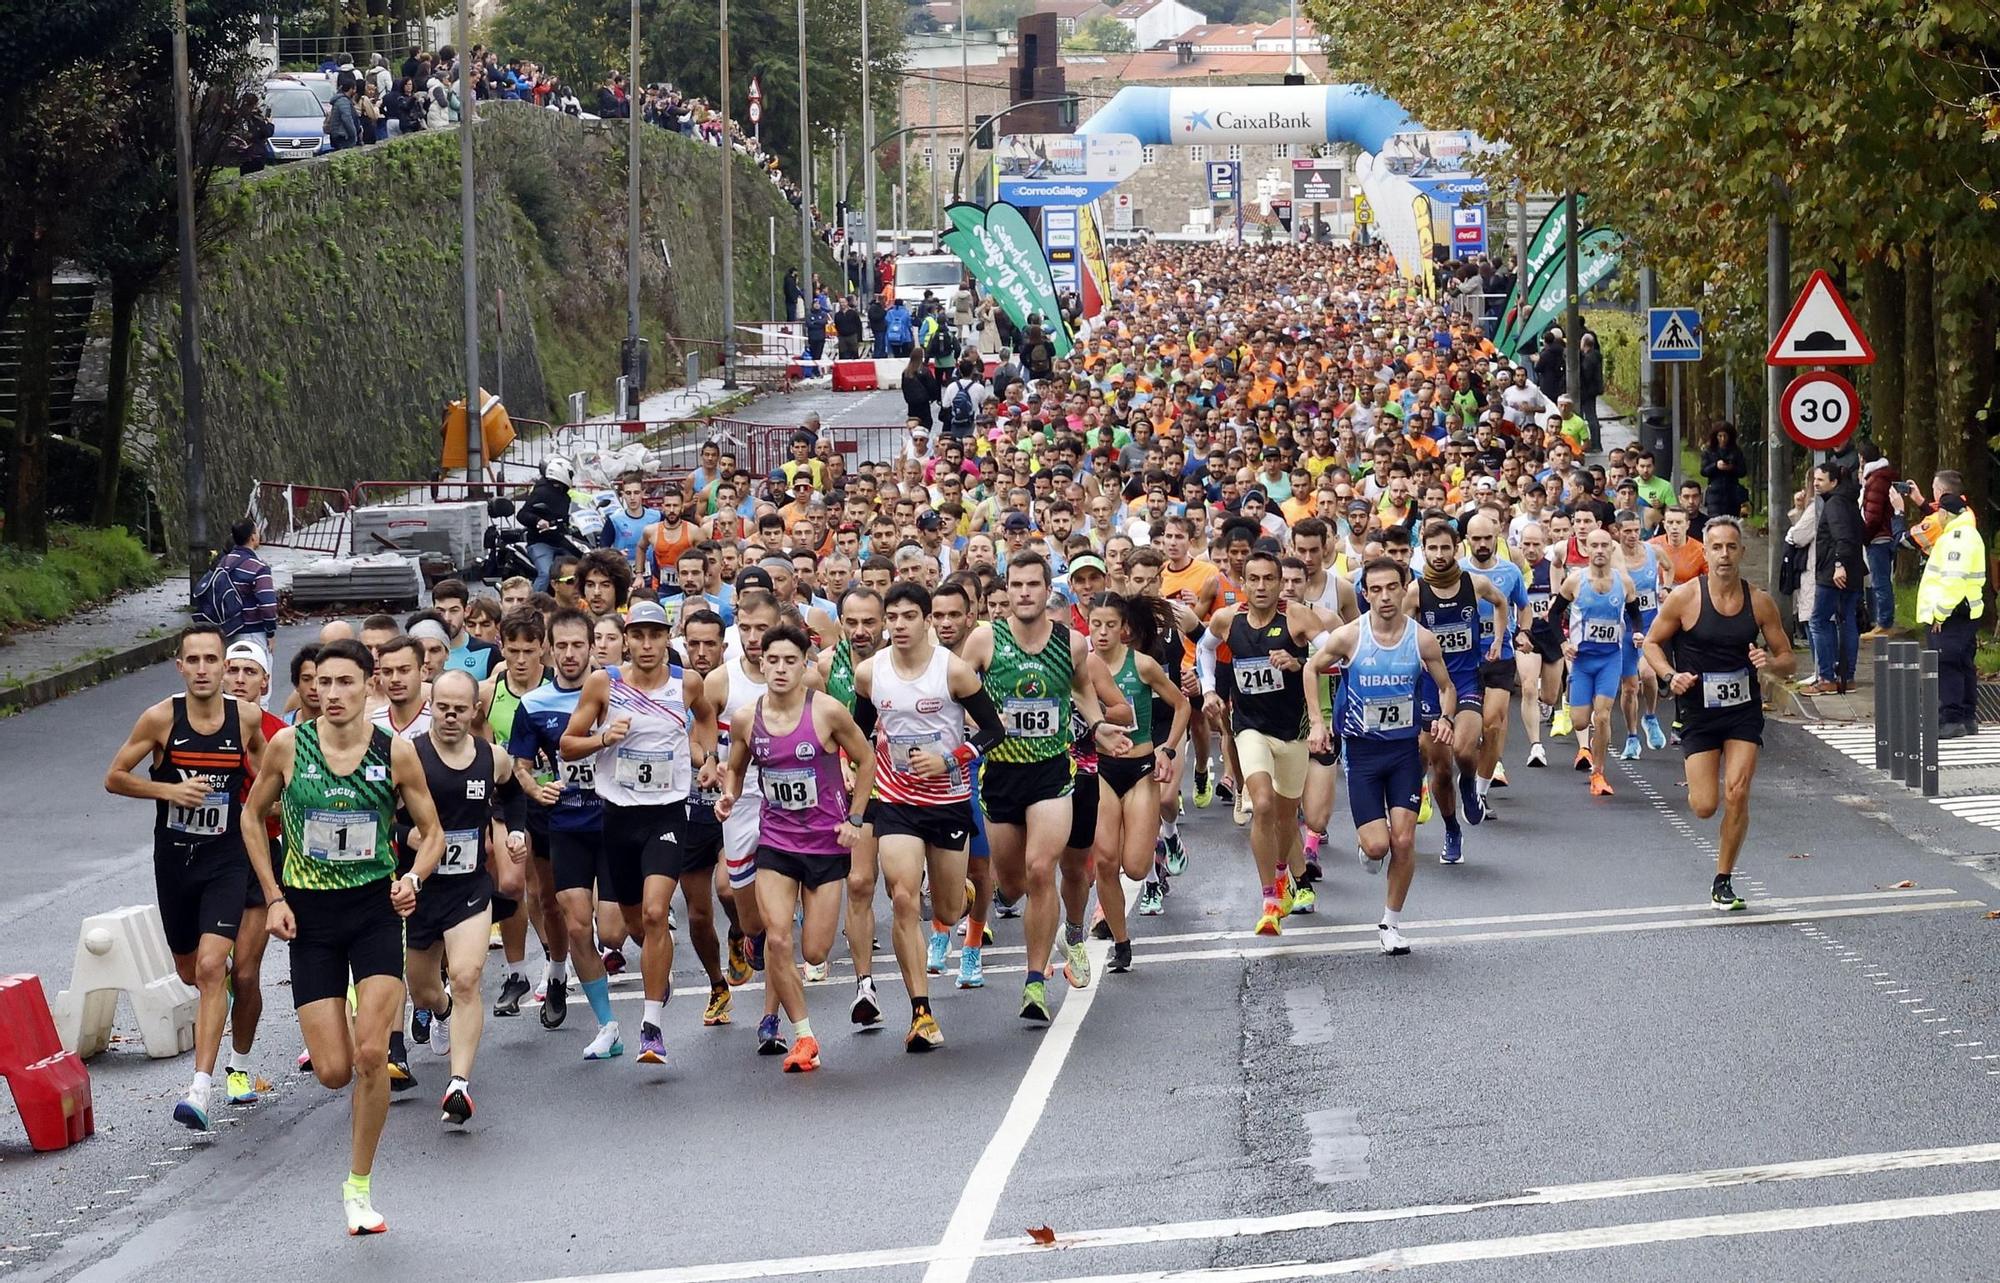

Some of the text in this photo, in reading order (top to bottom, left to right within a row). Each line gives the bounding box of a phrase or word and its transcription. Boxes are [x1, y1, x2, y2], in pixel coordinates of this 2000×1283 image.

[1216, 111, 1312, 129] CaixaBank
[1211, 164, 1232, 184] P
[1800, 398, 1842, 423] 30
[1530, 600, 1548, 613] 63
[1436, 632, 1467, 648] 235
[1590, 625, 1615, 639] 250
[1018, 663, 1044, 672] LUCUS
[1242, 669, 1274, 688] 214
[1717, 682, 1740, 700] 33
[1012, 711, 1050, 731] 163
[1378, 706, 1399, 724] 73
[567, 764, 597, 783] 25
[638, 764, 652, 784] 3
[324, 787, 356, 798] LUCUS
[771, 782, 807, 802] 103
[335, 828, 347, 851] 1
